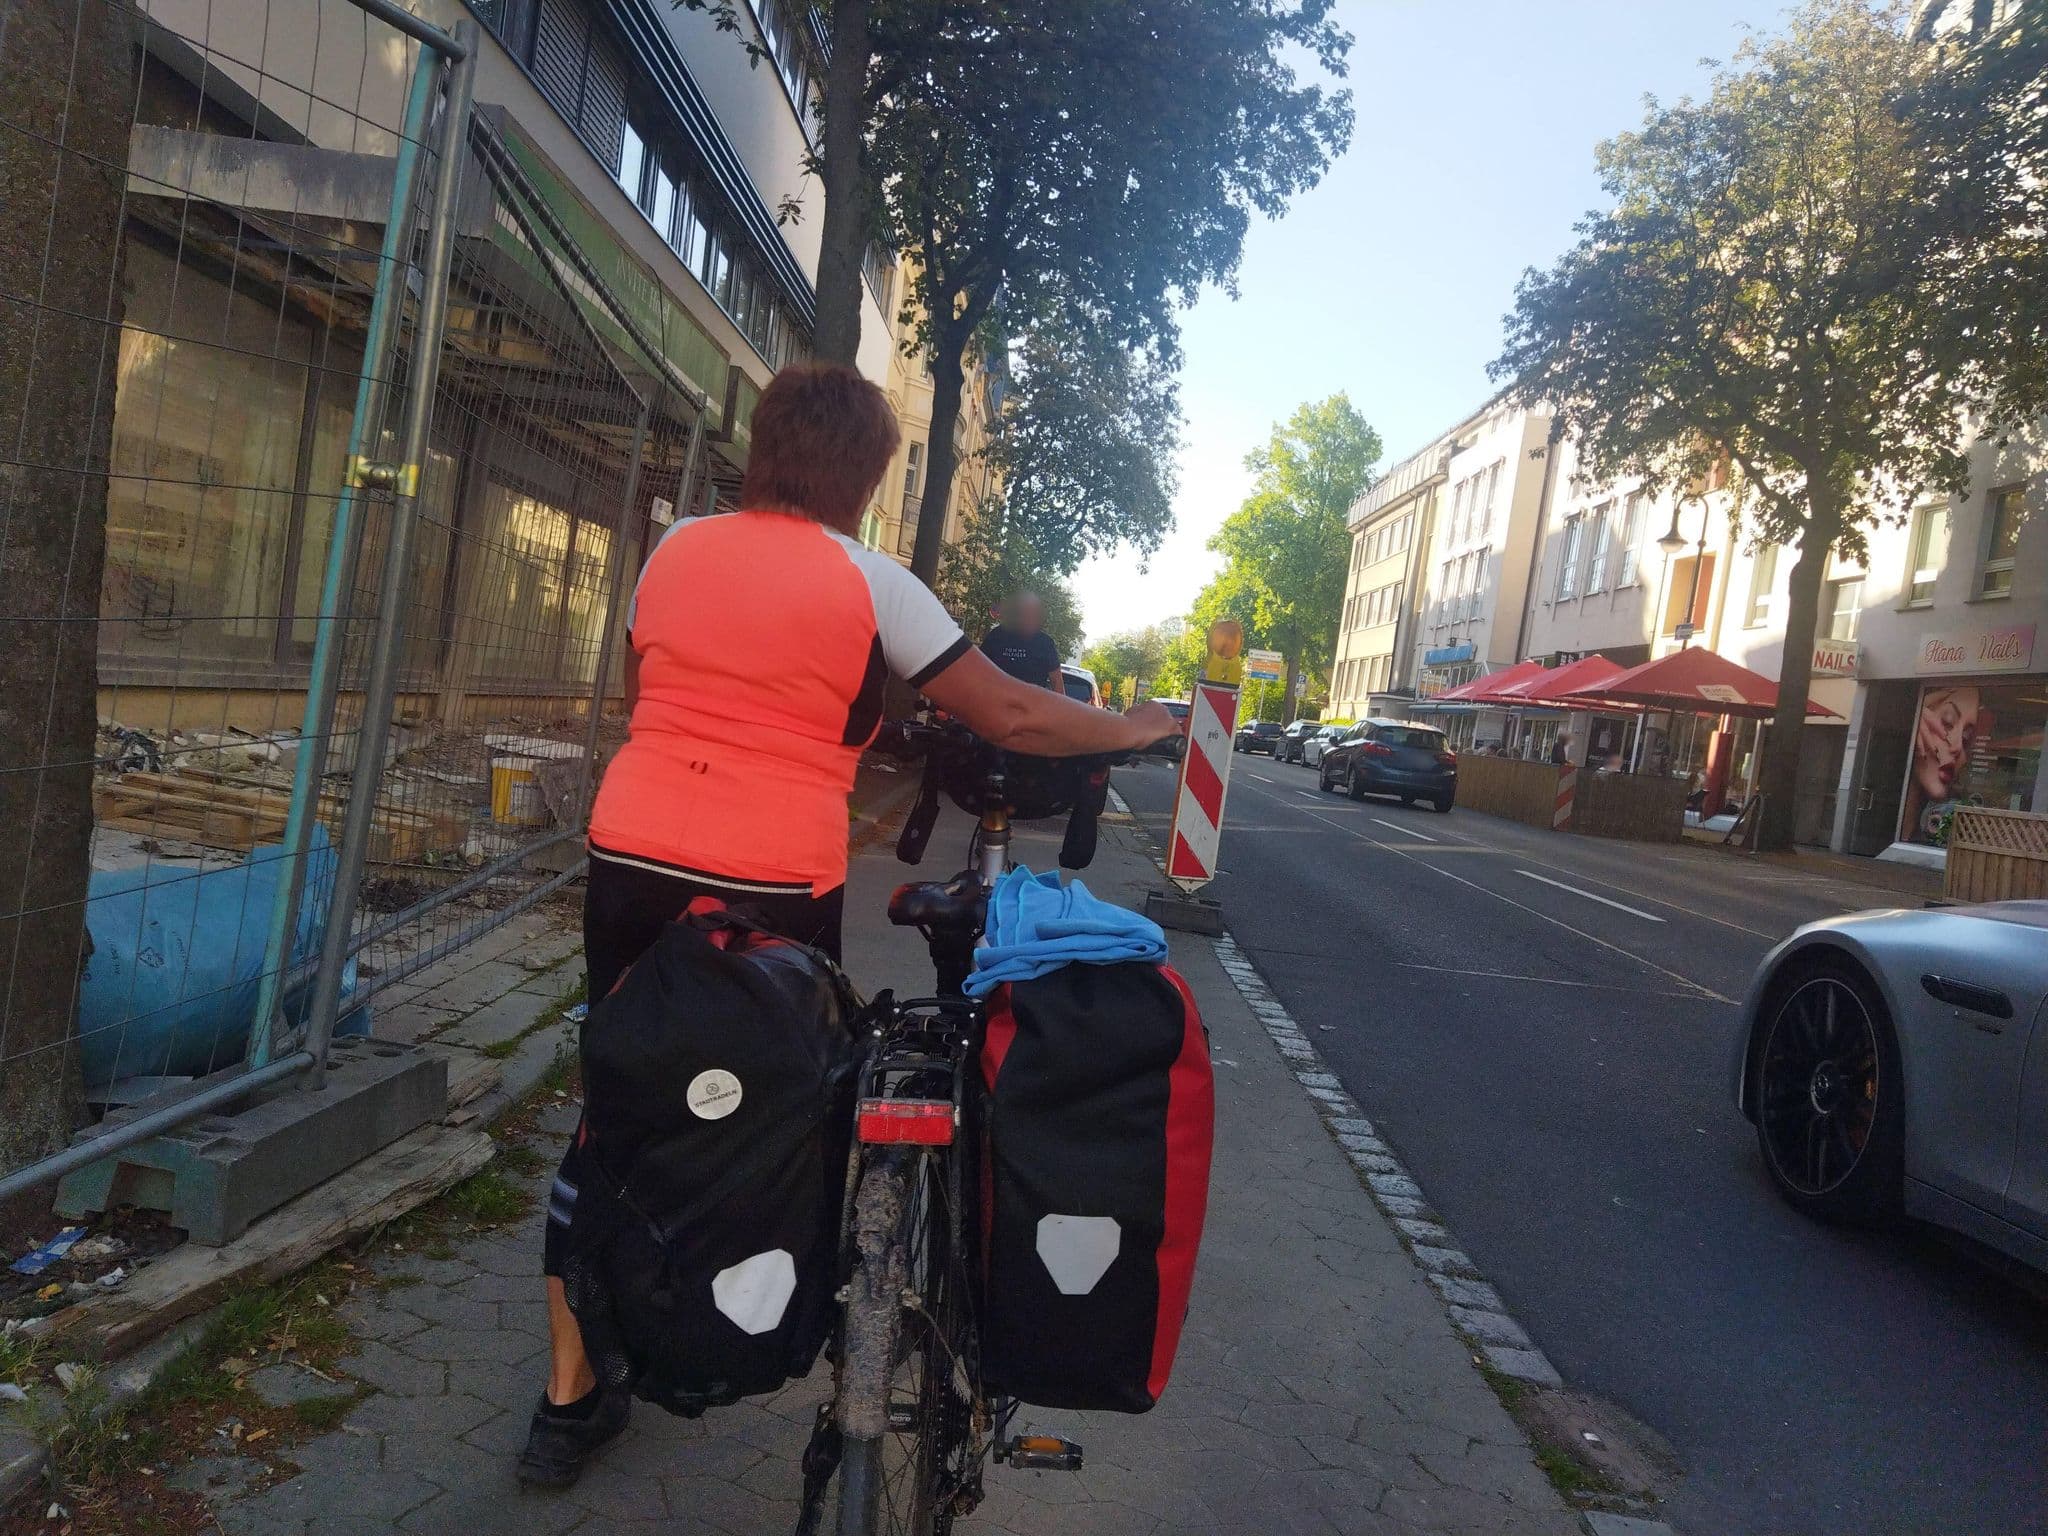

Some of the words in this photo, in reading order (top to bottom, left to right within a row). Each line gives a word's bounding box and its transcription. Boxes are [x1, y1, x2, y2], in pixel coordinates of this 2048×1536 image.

[1979, 633, 2020, 661] Nails
[1813, 650, 1855, 672] NAILS
[694, 1089, 737, 1108] STADTRADELN
